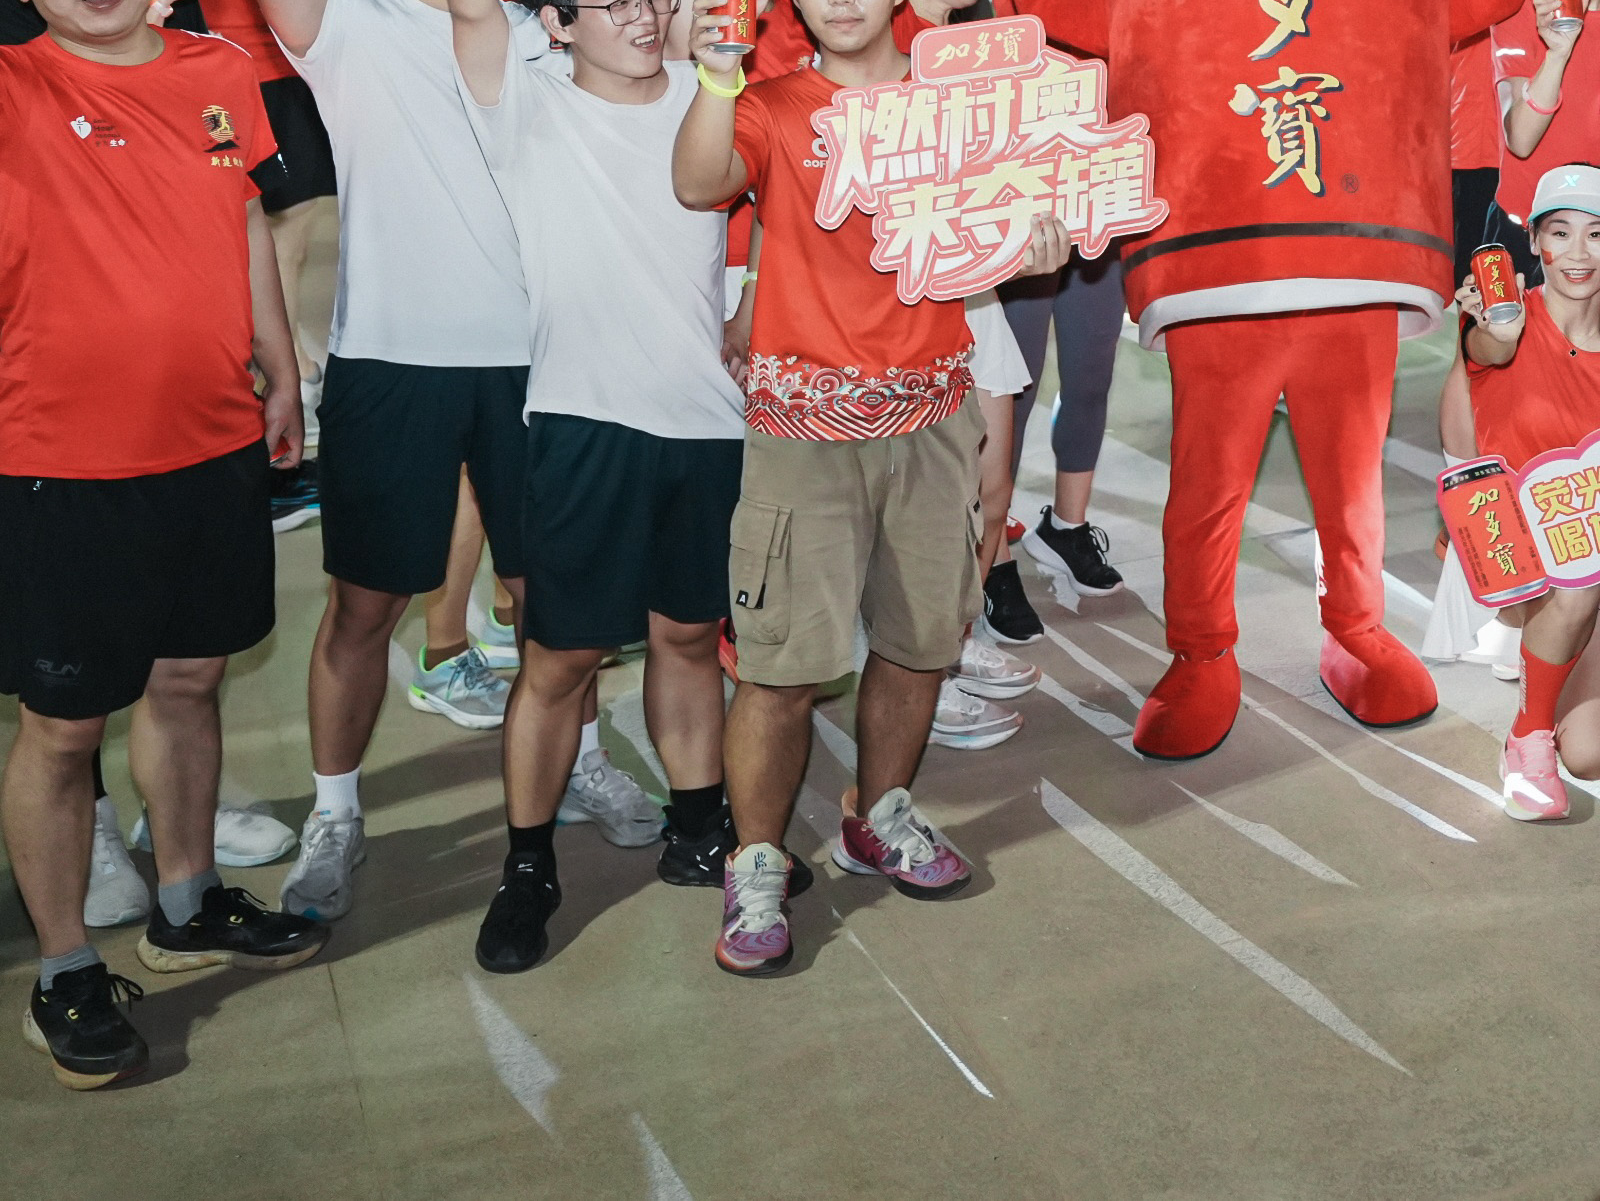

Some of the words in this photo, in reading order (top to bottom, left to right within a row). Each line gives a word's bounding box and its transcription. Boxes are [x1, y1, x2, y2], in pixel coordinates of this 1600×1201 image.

[822, 56, 1148, 221] 燃村奥
[883, 142, 1149, 297] 来夺罐
